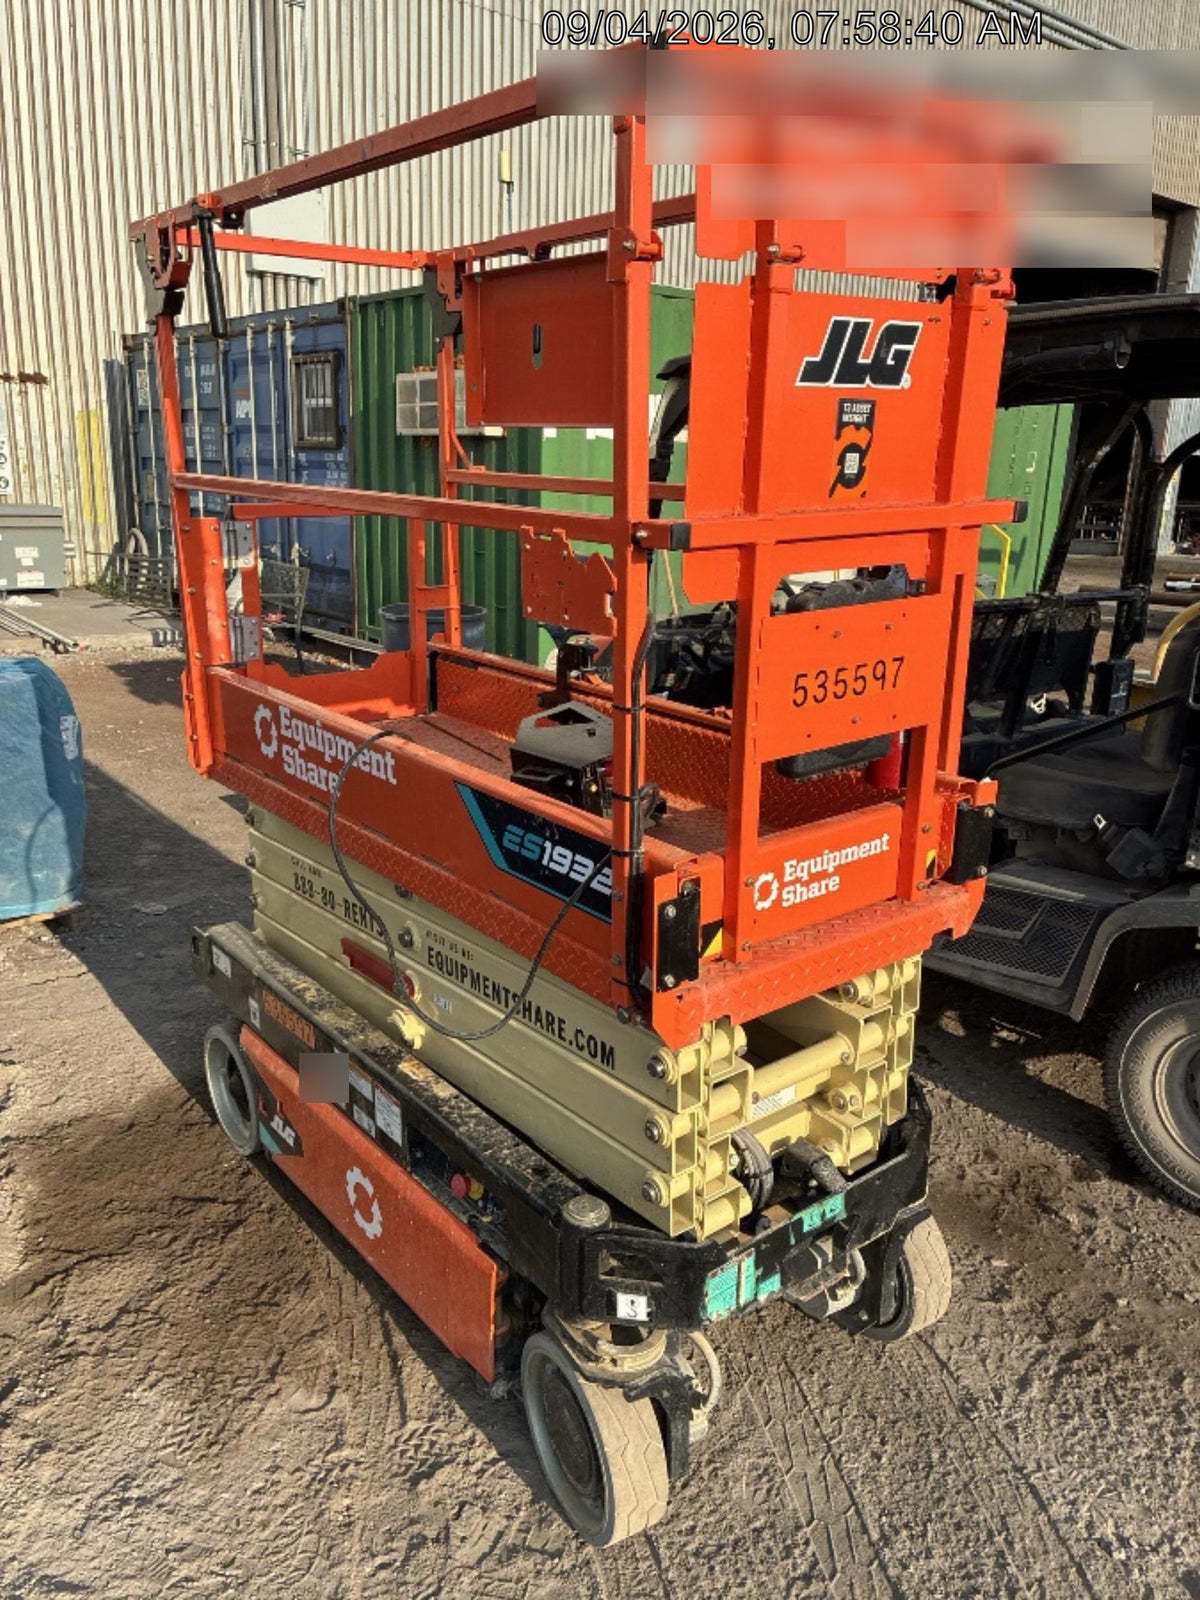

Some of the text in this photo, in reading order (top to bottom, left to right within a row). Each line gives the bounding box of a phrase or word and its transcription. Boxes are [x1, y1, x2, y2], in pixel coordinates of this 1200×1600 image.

[795, 316, 922, 389] JLG
[792, 656, 904, 708] 535597
[278, 705, 397, 785] Equipment
[282, 744, 342, 797] Share
[503, 824, 612, 897] ES1932
[783, 833, 889, 882] Equipment
[782, 875, 840, 907] Share
[427, 945, 616, 1070] EQUIPMENTSHARE.COM
